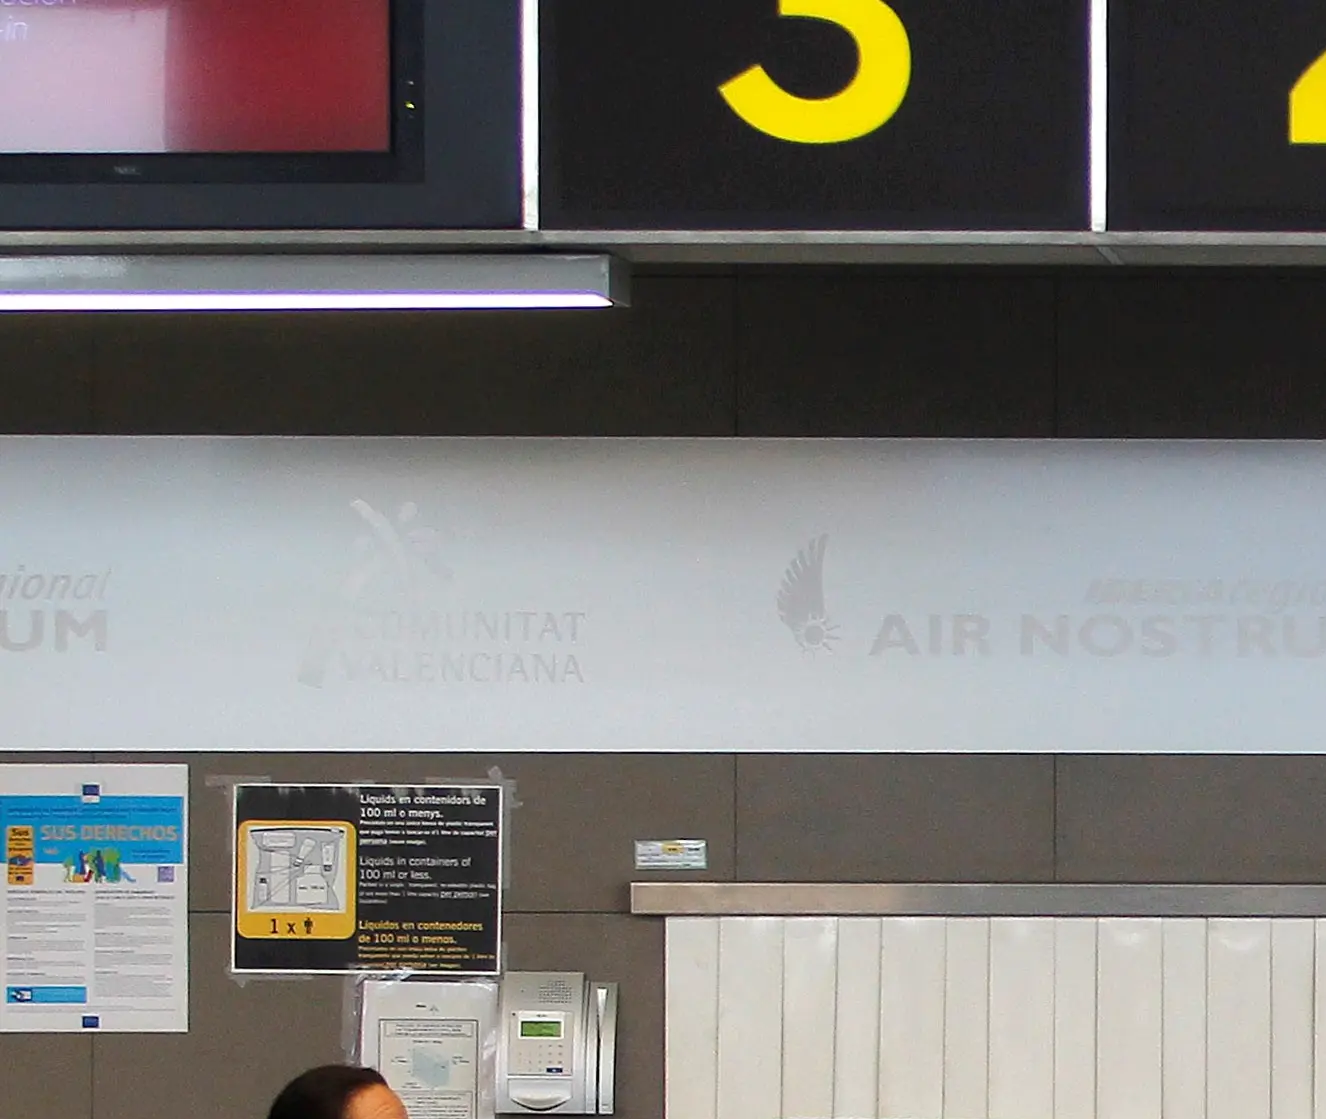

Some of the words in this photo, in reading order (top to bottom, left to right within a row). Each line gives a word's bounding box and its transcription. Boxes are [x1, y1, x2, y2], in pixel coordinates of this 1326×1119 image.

[868, 613, 991, 657] AIR
[473, 795, 487, 805] de
[360, 808, 381, 817] 100
[81, 825, 178, 841] DERECHOS
[360, 869, 381, 880] 100
[269, 919, 279, 934] 1
[417, 921, 484, 931] contenedores
[374, 934, 394, 943] 100
